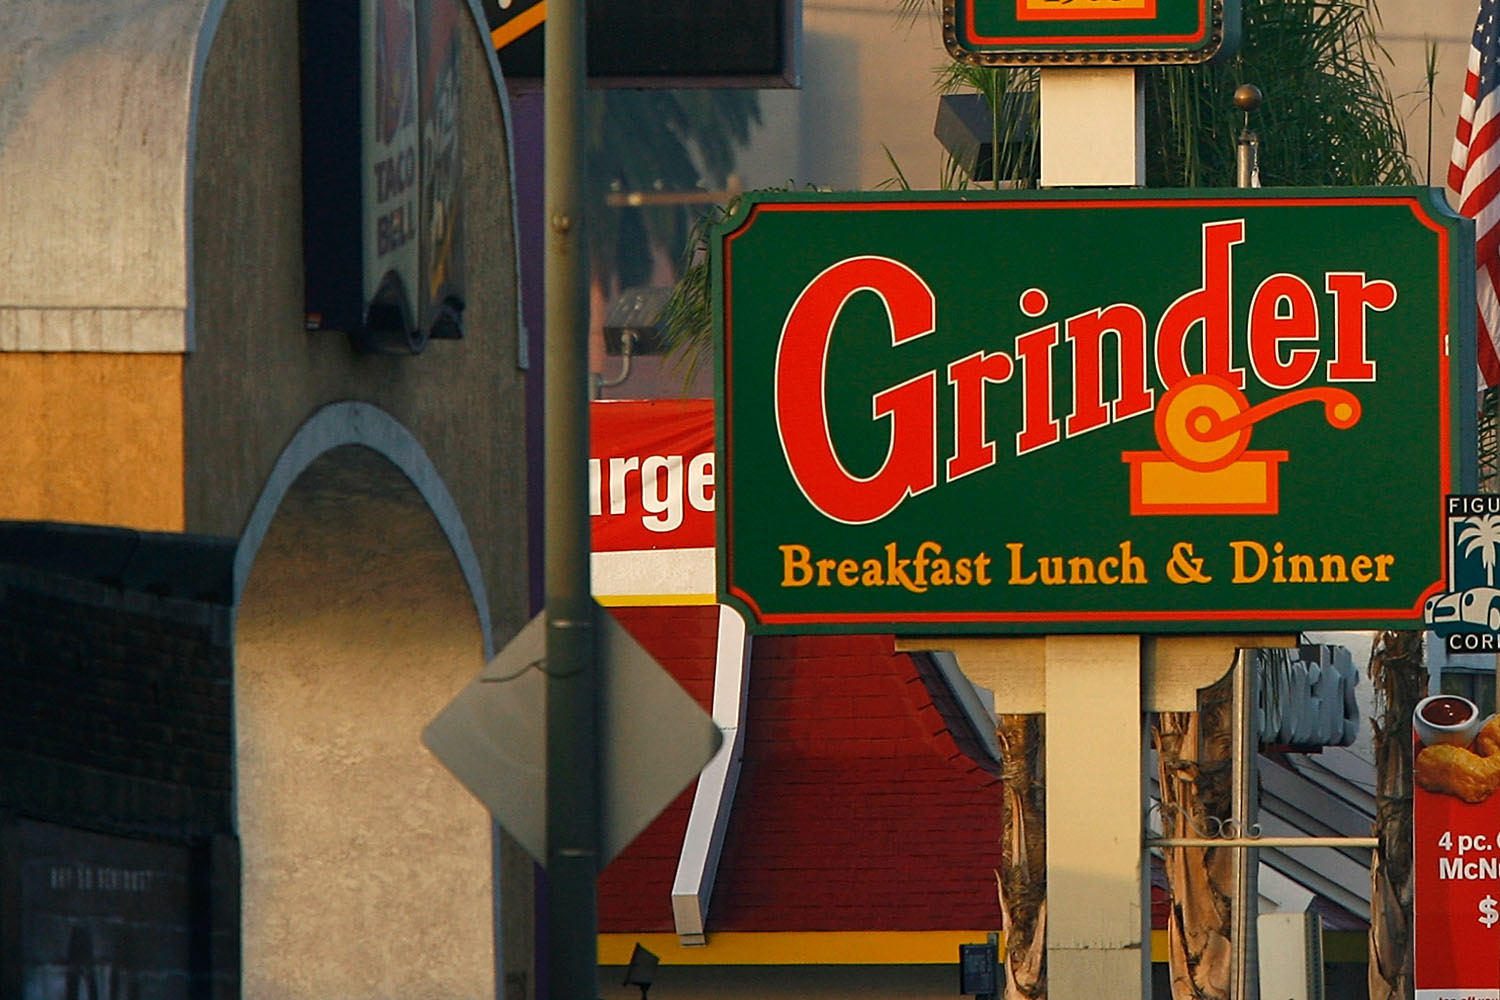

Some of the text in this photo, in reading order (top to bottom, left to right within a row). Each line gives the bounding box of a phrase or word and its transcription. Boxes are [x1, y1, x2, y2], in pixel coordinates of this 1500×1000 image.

[775, 218, 1398, 525] Grinder
[780, 541, 1396, 592] Breakfast Lunch & Dinner
[1438, 831, 1453, 851] 4
[1458, 835, 1492, 855] pc.
